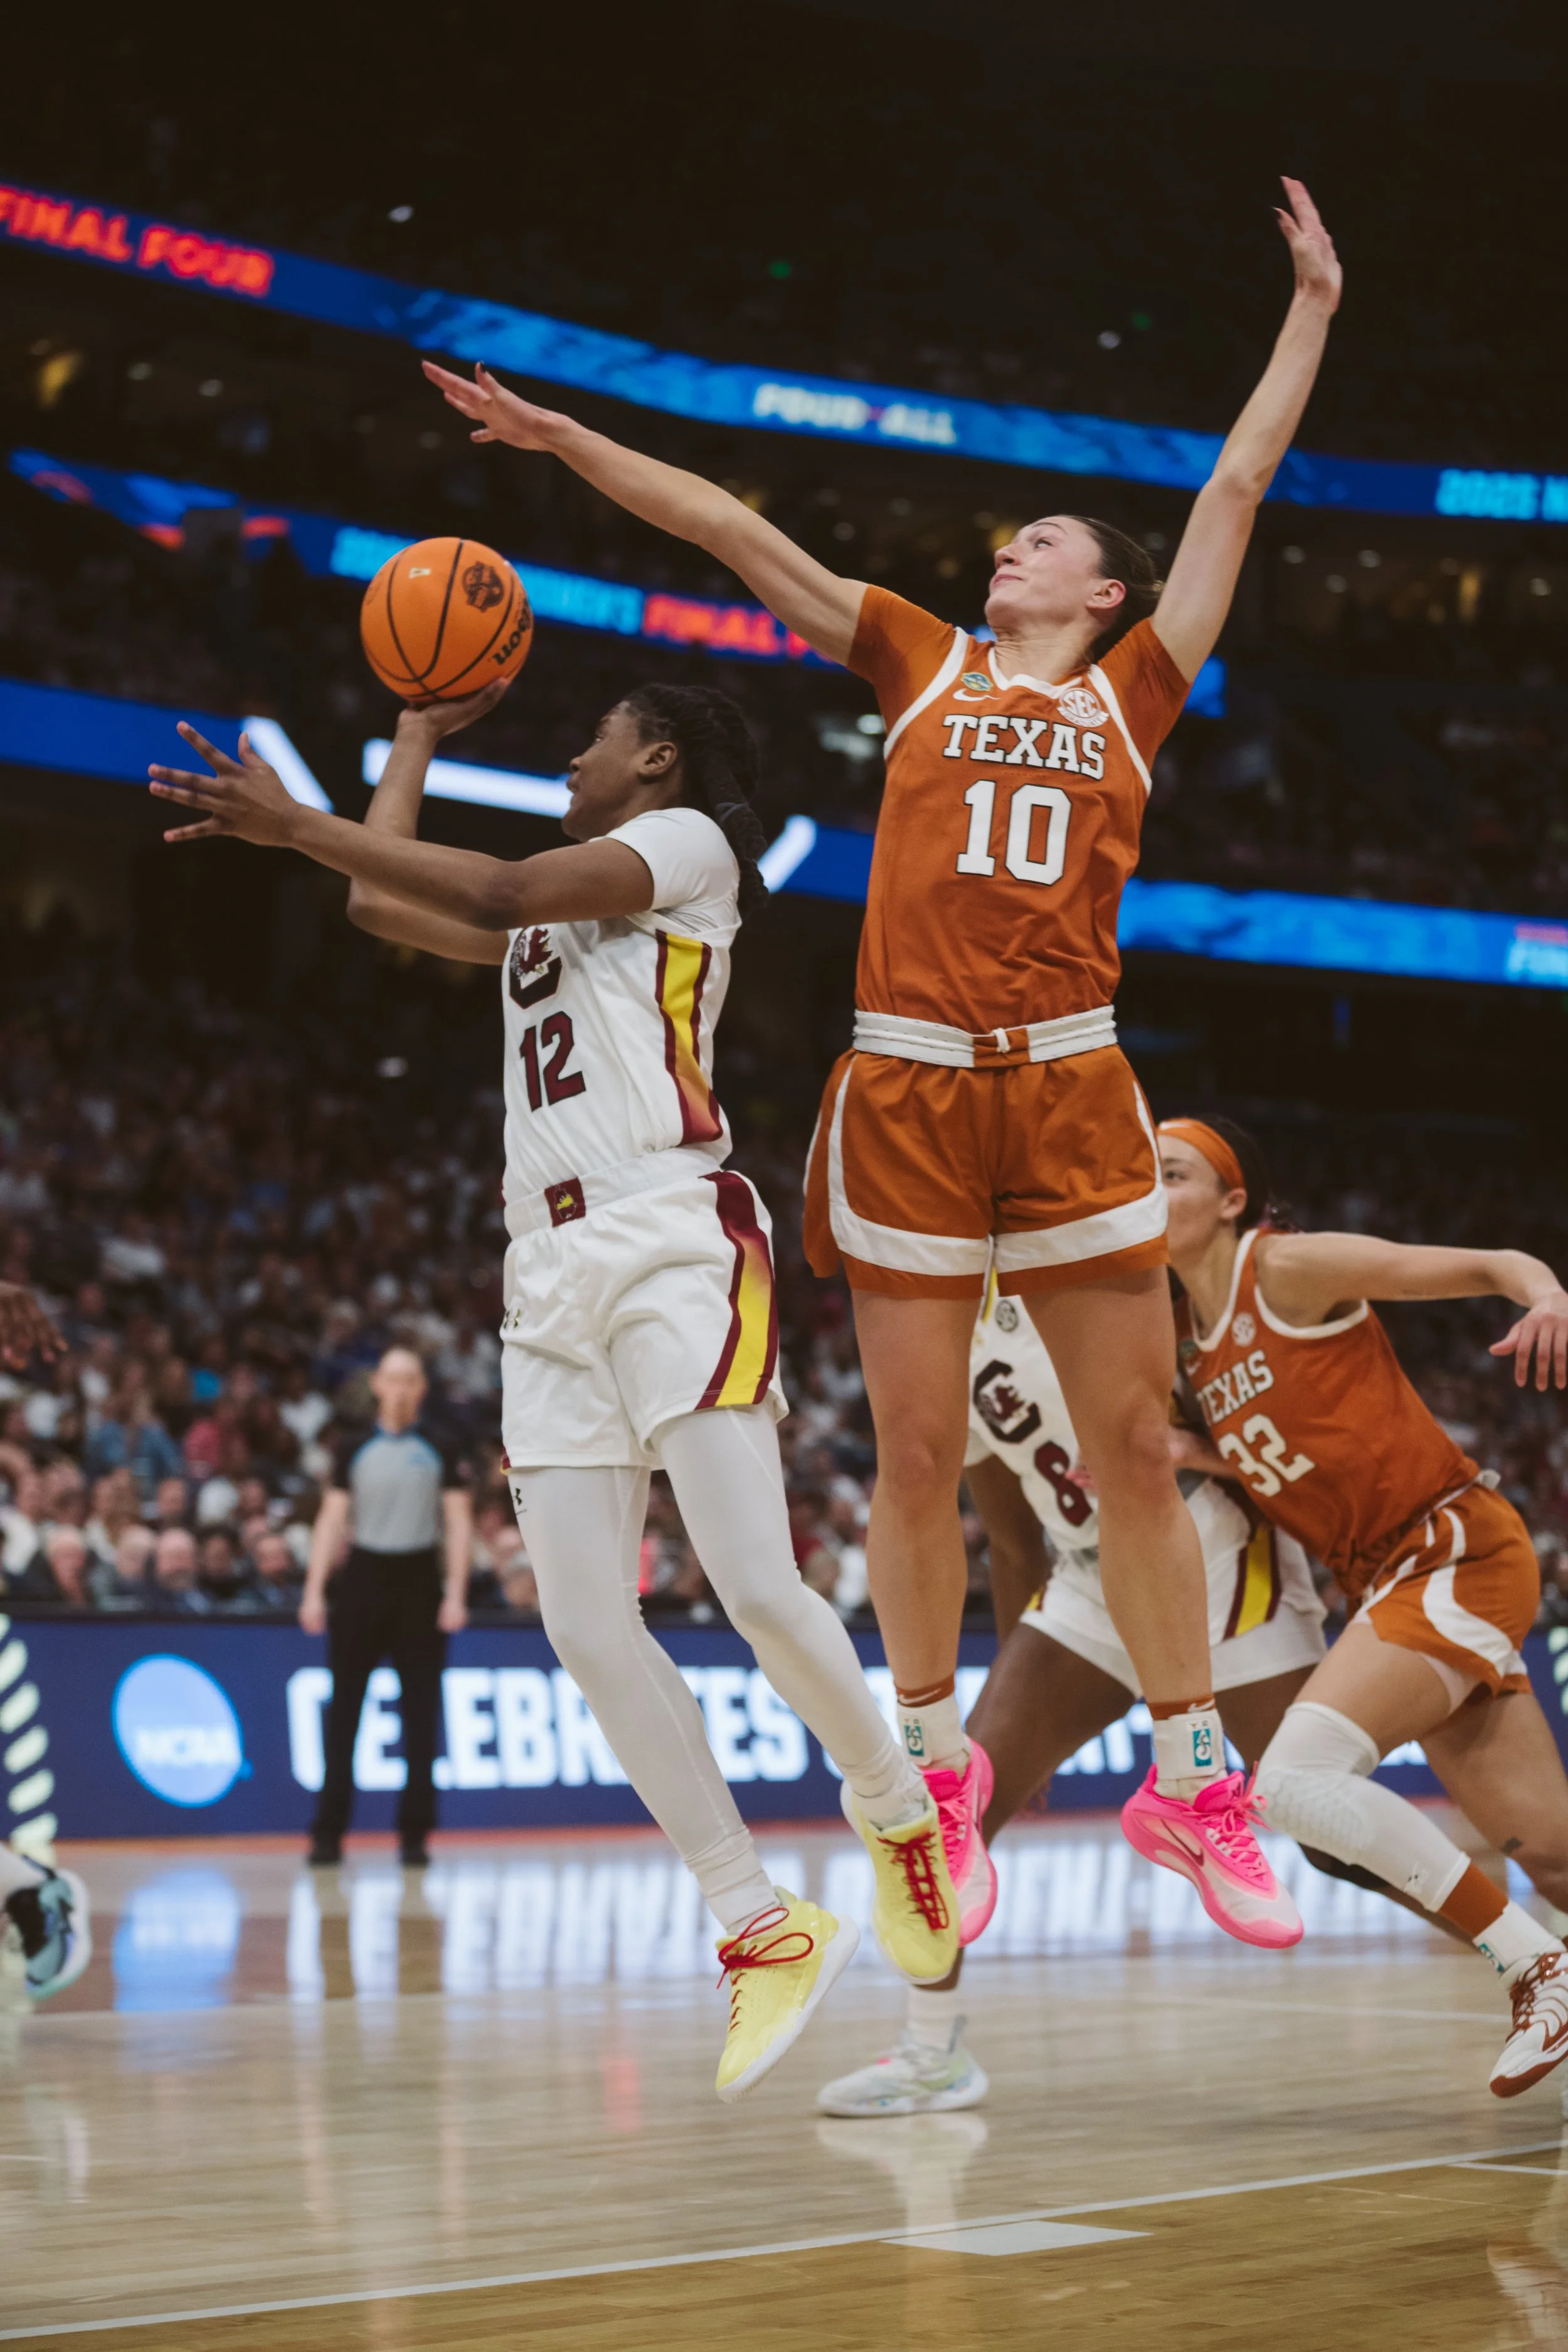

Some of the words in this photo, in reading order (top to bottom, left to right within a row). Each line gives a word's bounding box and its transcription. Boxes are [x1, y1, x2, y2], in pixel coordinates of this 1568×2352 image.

[137, 224, 275, 299] FOUR
[942, 713, 1106, 780] TEXAS
[1062, 690, 1099, 718] SEC
[955, 778, 1072, 886] 10
[519, 1010, 586, 1112] 12
[1033, 1440, 1093, 1527] 8
[1217, 1412, 1316, 1498] 32
